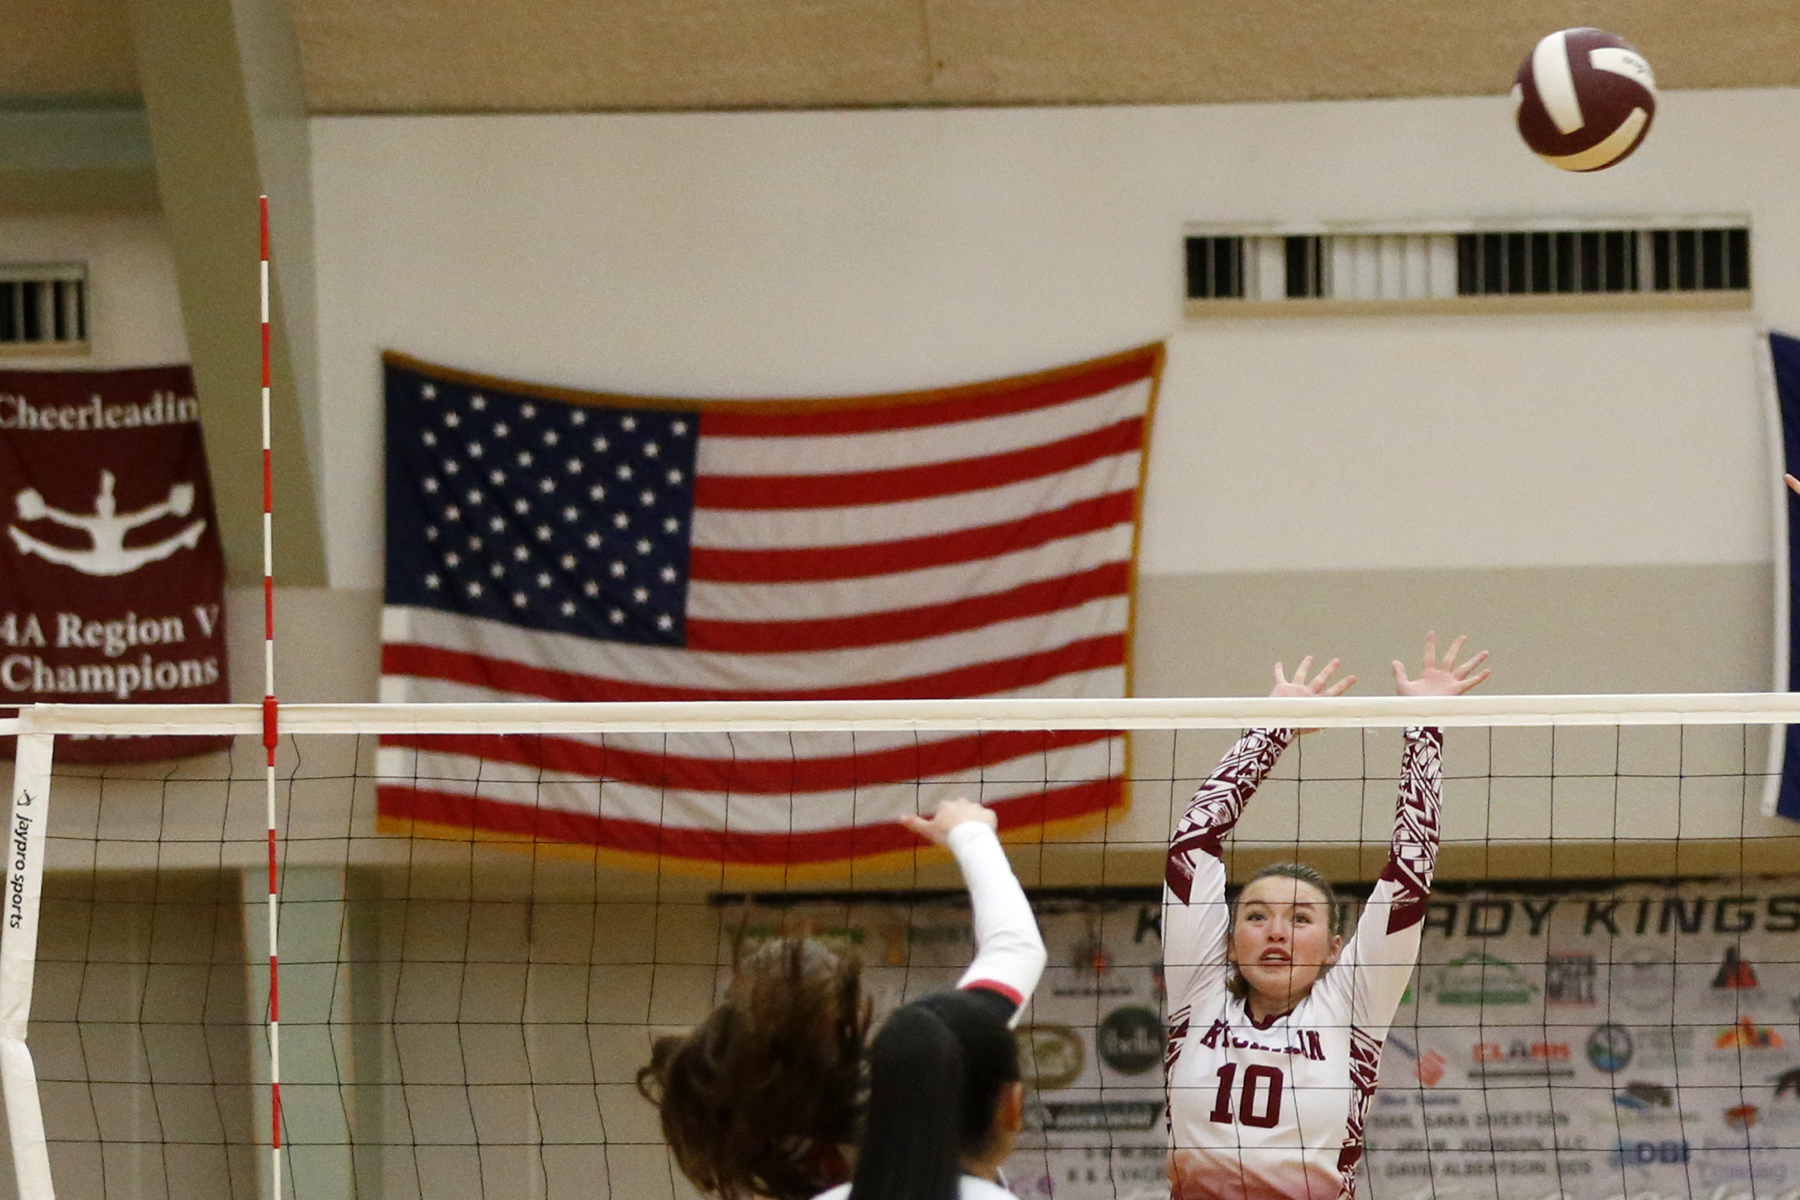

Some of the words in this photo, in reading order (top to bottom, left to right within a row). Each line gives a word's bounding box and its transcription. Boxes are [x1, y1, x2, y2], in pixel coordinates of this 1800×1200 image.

[0, 612, 46, 648] 4A
[56, 610, 186, 658] Region
[193, 603, 219, 639] V
[1, 653, 219, 700] Champions
[14, 813, 33, 871] jaypro
[10, 873, 25, 929] sports
[1425, 897, 1556, 937] ADY
[1209, 1062, 1284, 1129] 10
